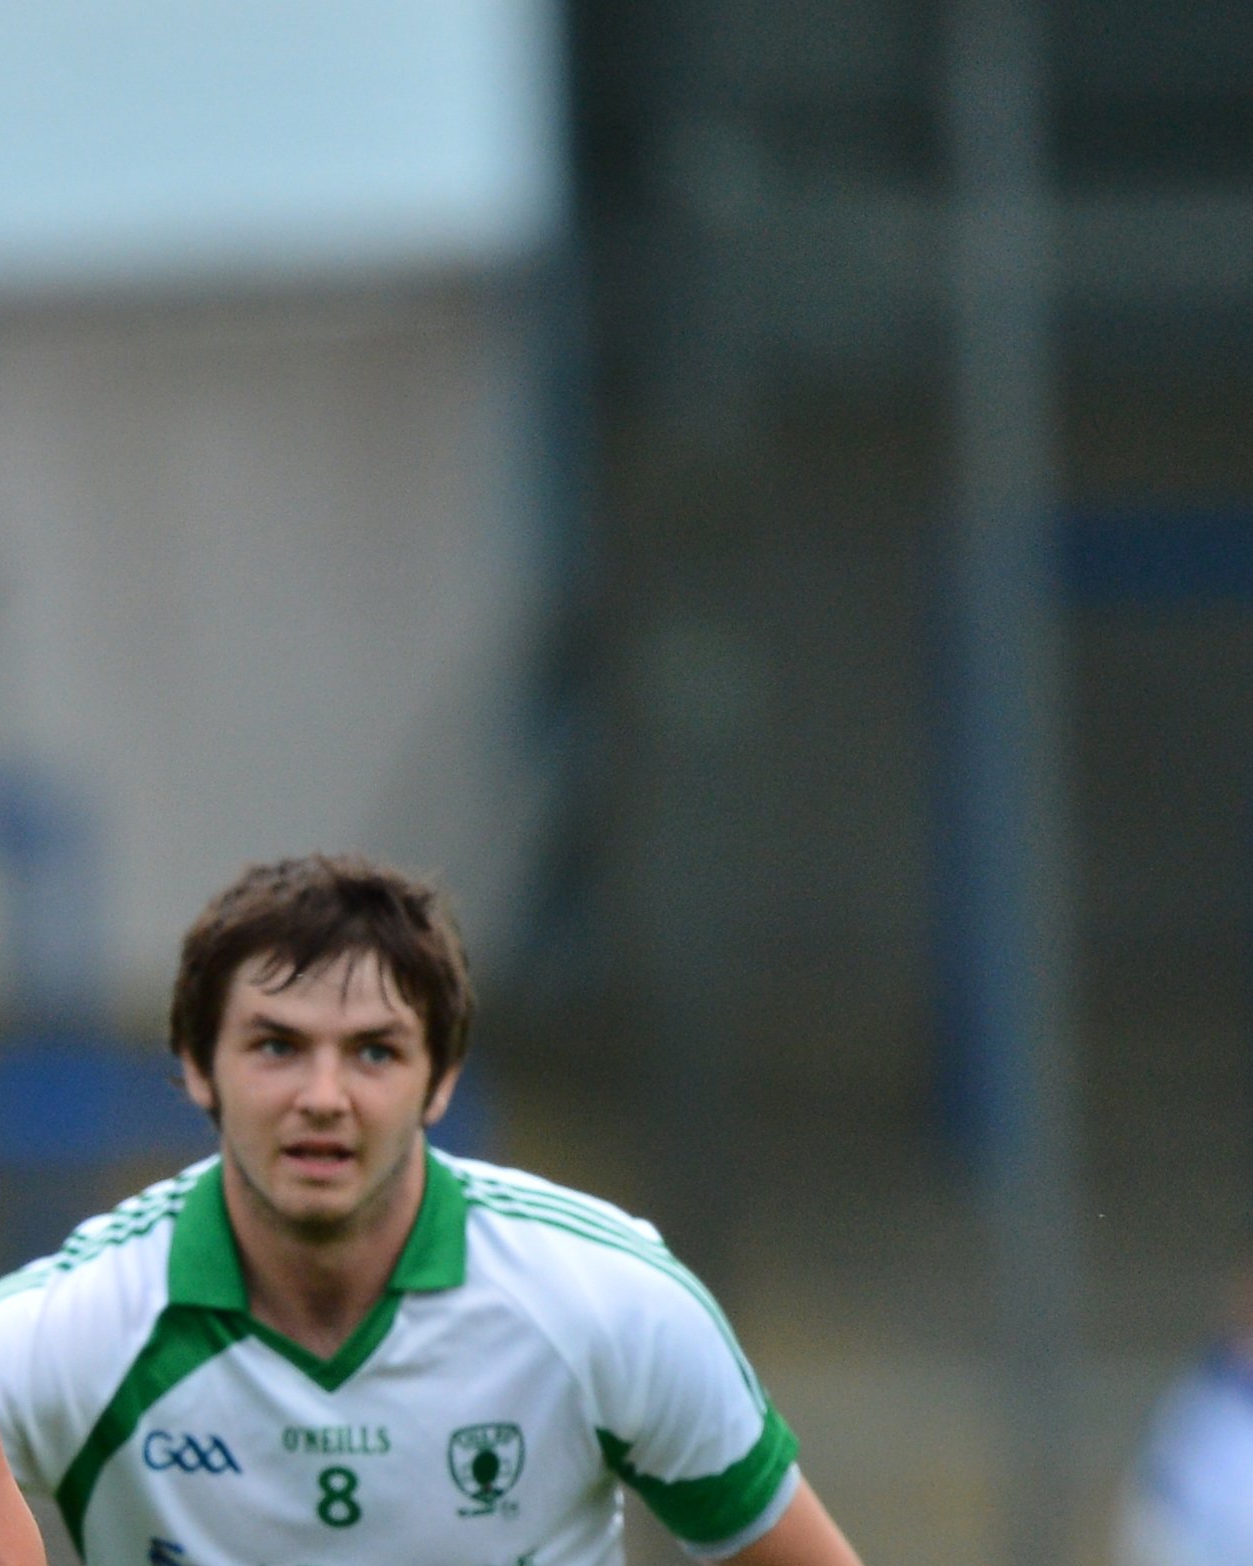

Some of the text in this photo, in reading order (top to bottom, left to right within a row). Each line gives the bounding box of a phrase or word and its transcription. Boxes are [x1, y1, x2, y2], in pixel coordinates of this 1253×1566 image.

[143, 1430, 242, 1474] GAA
[281, 1425, 391, 1454] O'NEILLS
[317, 1465, 362, 1528] 8
